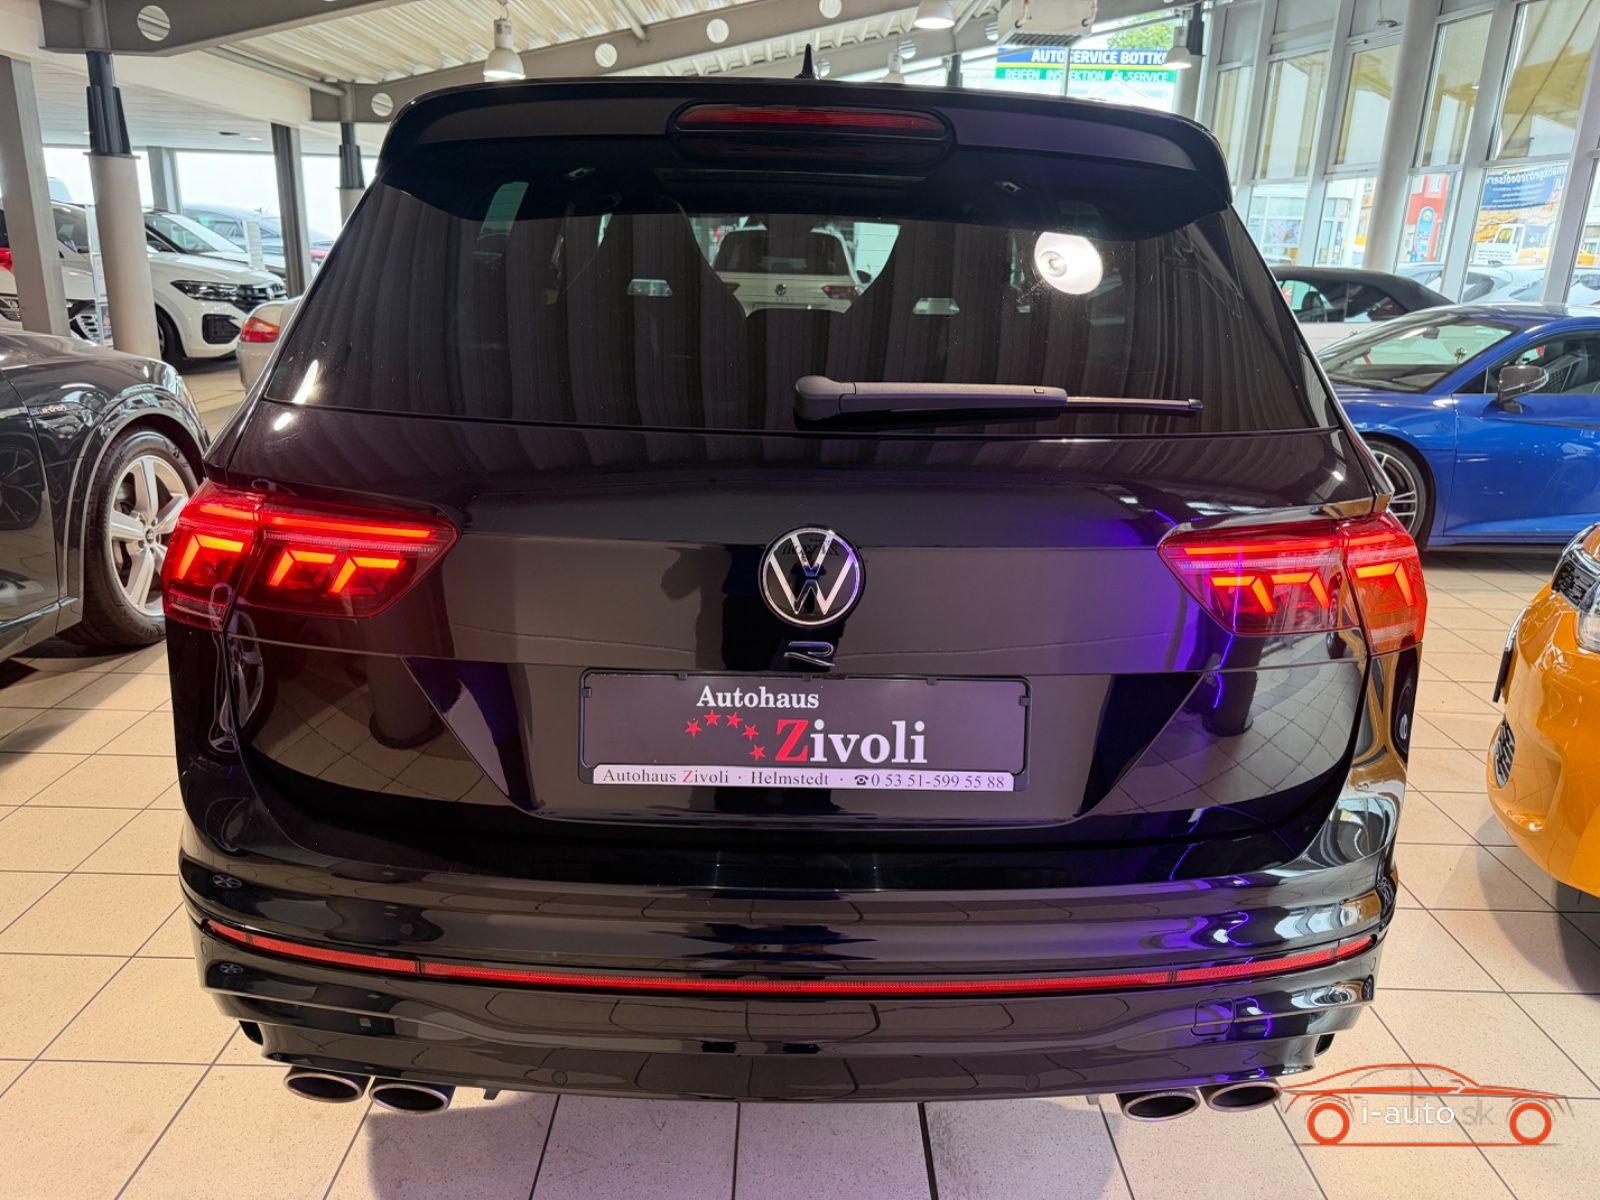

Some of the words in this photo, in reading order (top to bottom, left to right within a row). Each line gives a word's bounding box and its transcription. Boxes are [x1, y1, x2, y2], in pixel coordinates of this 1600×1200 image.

[1005, 69, 1040, 80] REIFEN
[1047, 70, 1105, 81] INSEKTION
[696, 685, 819, 709] Autohaus
[775, 718, 928, 764] Zivoli
[603, 769, 677, 783] Autohaus
[682, 769, 729, 784] Zivoli
[751, 771, 829, 785] Helmstedt
[885, 774, 902, 787] 53
[908, 774, 960, 788] 51-599
[964, 775, 982, 788] 55
[987, 775, 1005, 788] 88
